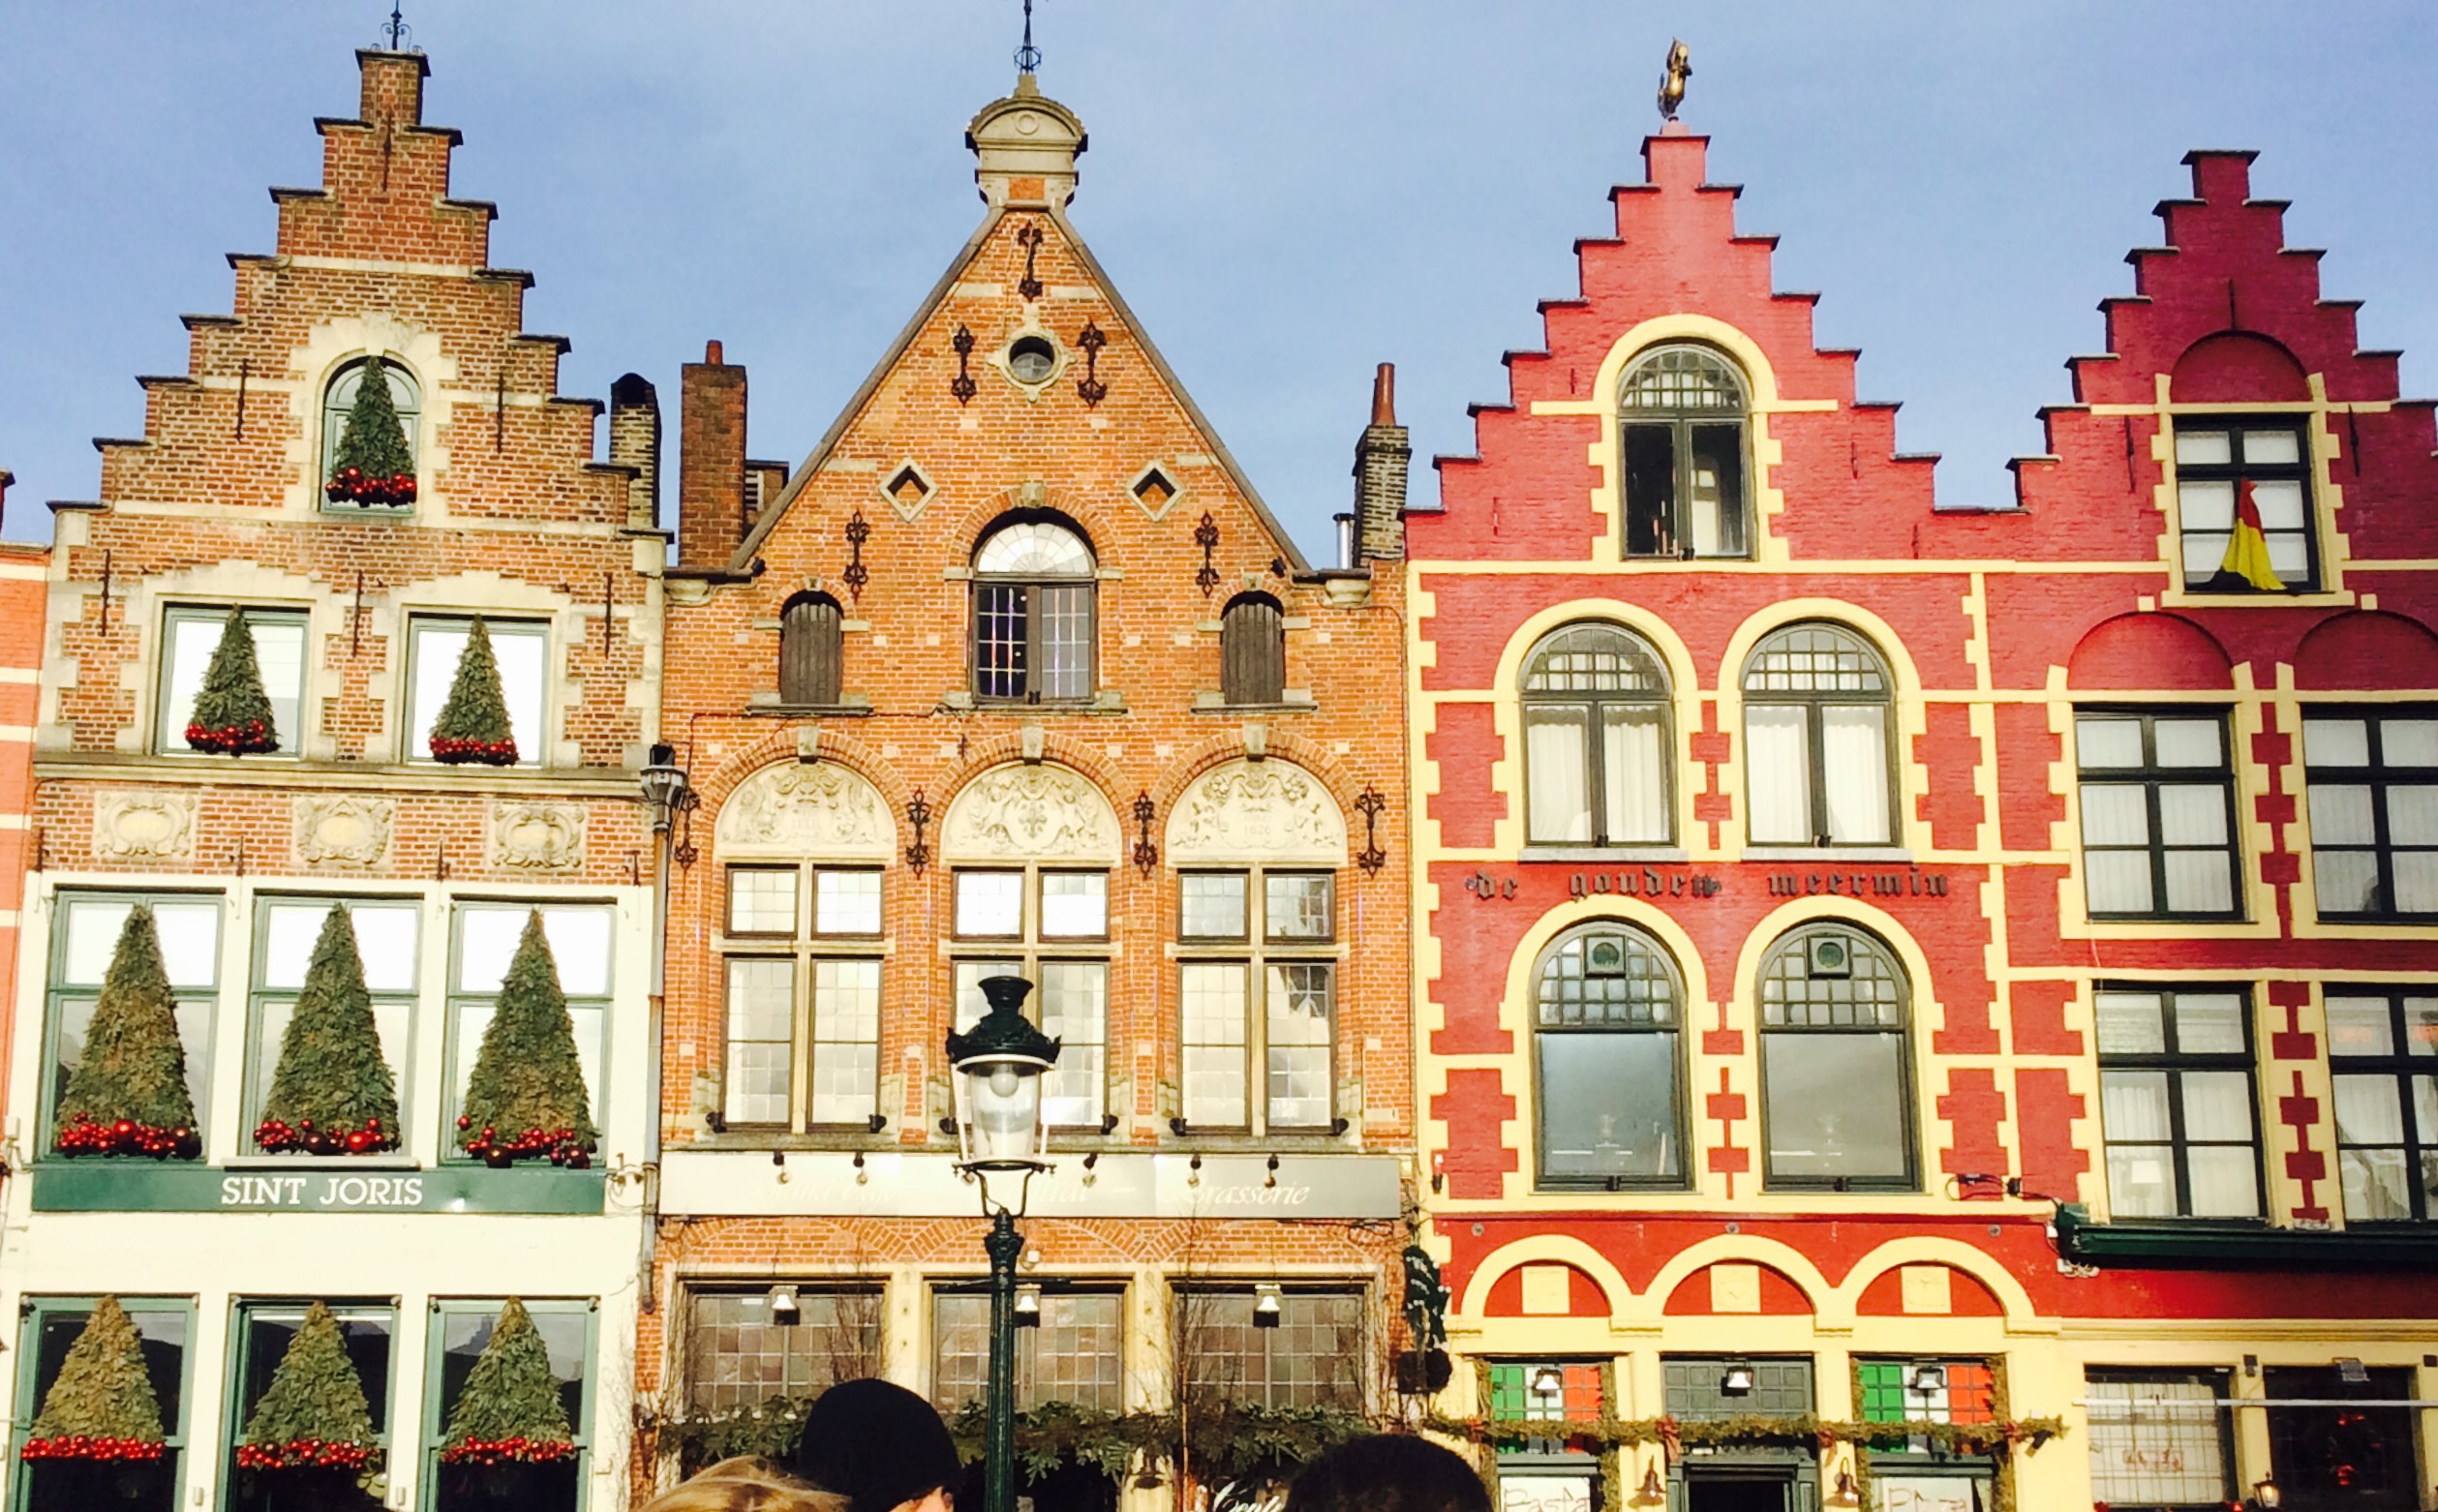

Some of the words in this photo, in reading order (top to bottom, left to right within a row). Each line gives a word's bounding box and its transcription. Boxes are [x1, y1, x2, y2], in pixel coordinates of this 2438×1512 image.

[1476, 869, 1518, 900] de
[1569, 865, 1715, 903] gouden
[1767, 864, 1949, 896] meermin
[221, 1176, 307, 1205] SINT
[319, 1177, 423, 1206] JORIS
[1168, 1177, 1312, 1205] Brasserie
